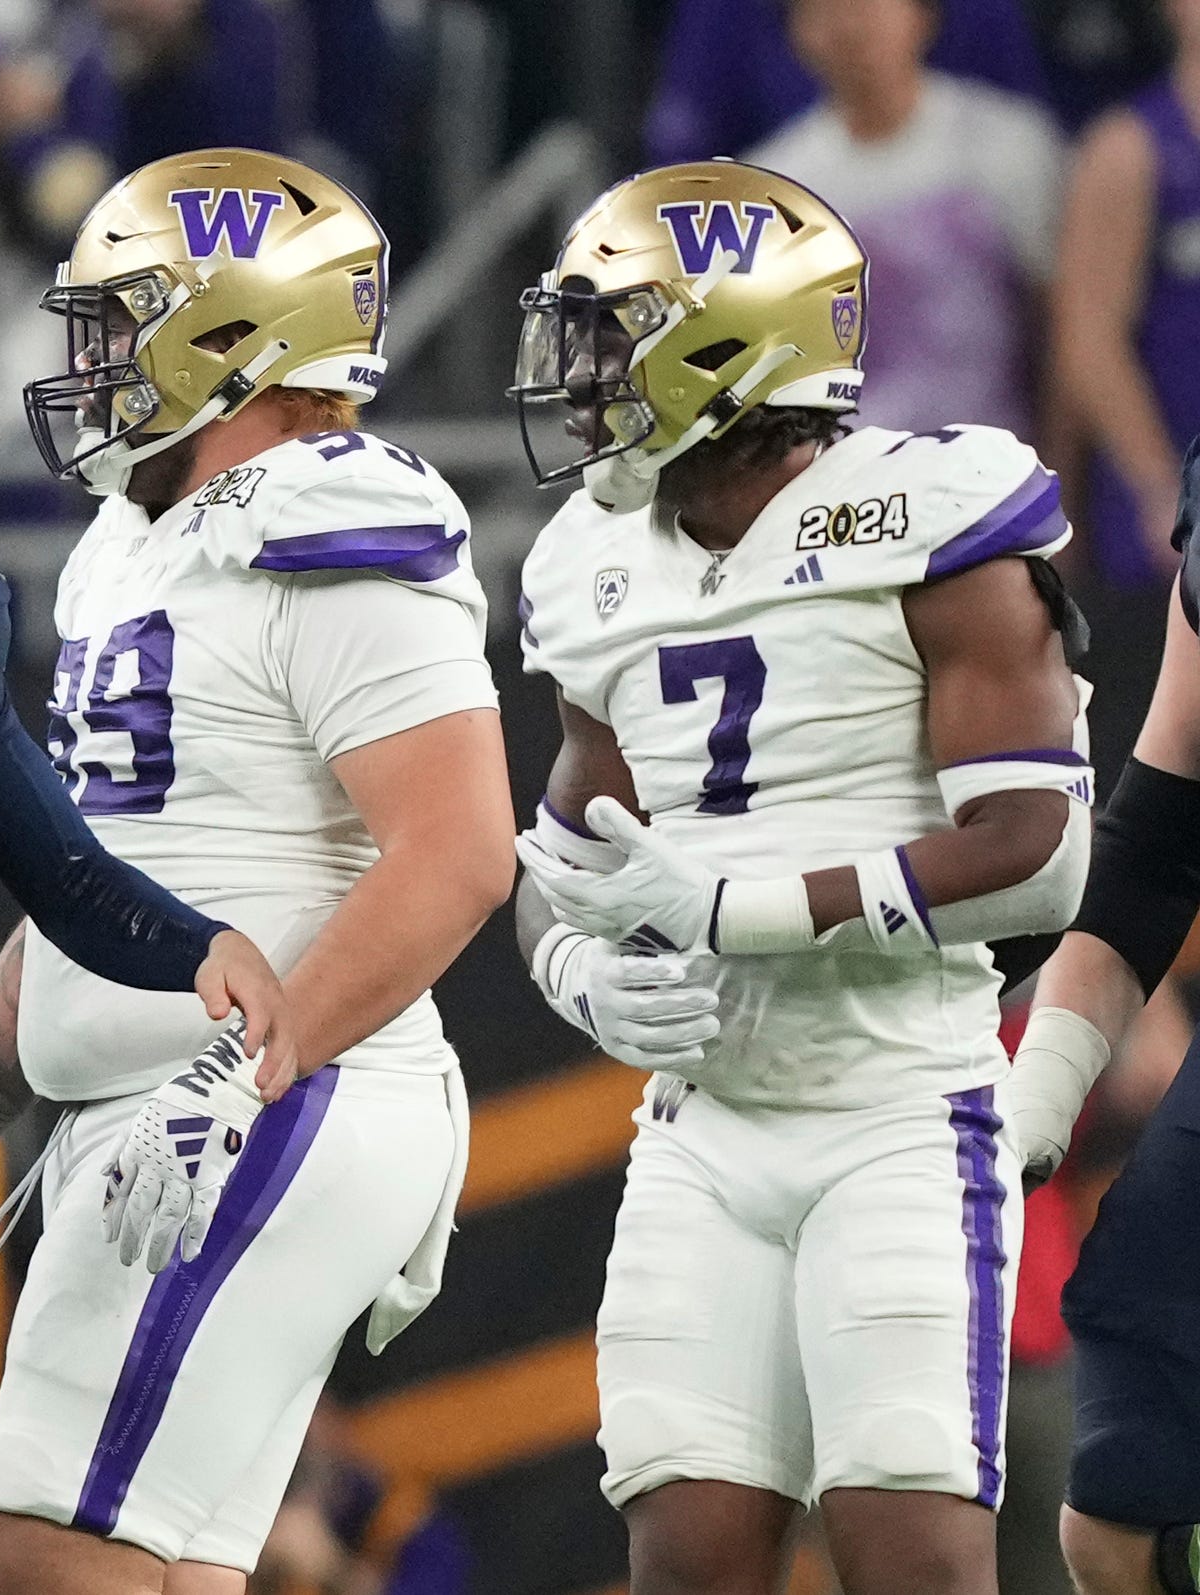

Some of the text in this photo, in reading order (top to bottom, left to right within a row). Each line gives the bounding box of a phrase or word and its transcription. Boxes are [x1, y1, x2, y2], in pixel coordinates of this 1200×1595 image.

[167, 188, 285, 261] W
[657, 200, 776, 277] W
[193, 467, 267, 509] 2024
[796, 493, 908, 551] 2024
[599, 593, 619, 614] 12
[658, 635, 768, 815] 7
